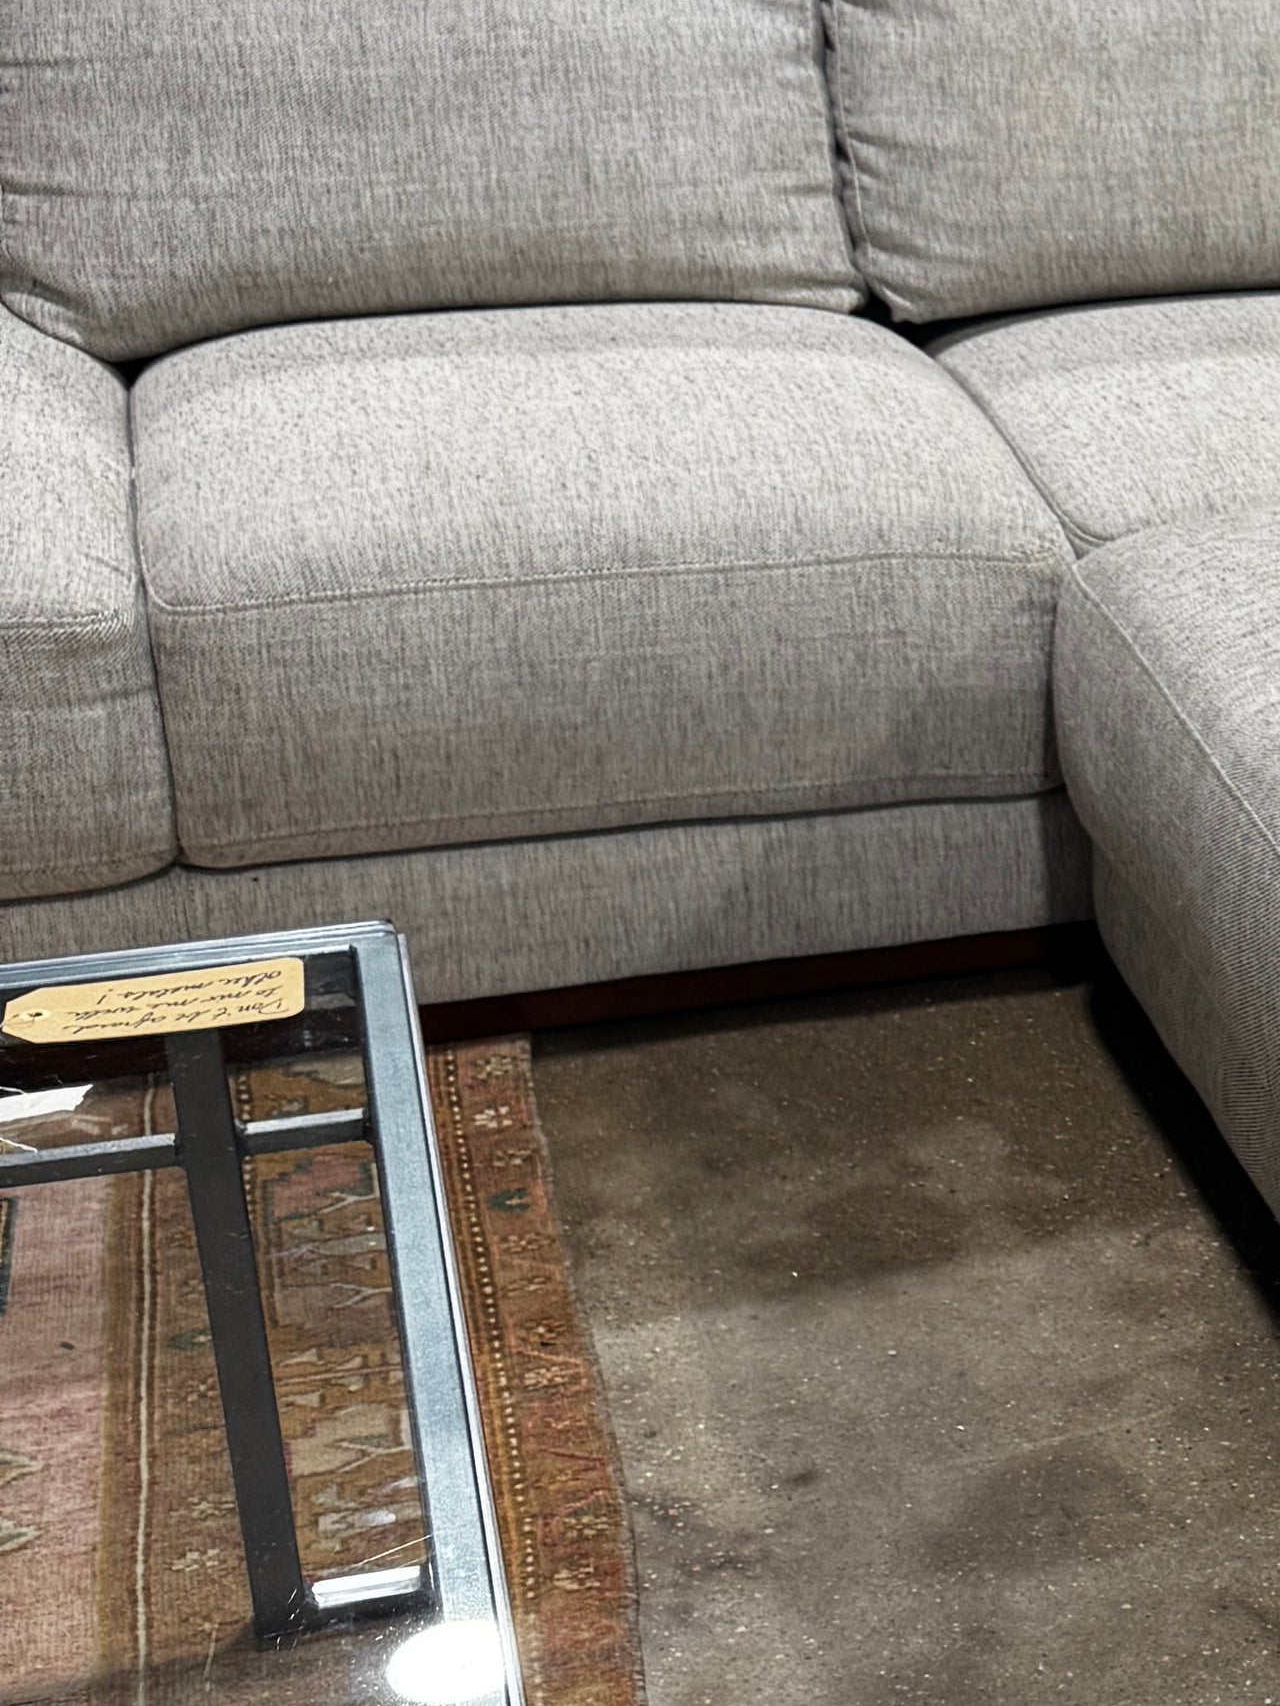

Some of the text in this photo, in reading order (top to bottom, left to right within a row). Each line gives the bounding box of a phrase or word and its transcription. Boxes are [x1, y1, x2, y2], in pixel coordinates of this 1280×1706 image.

[218, 970, 282, 988] other
[256, 985, 283, 998] to
[146, 997, 199, 1009] me
[66, 1006, 141, 1021] with
[175, 1009, 211, 1023] be
